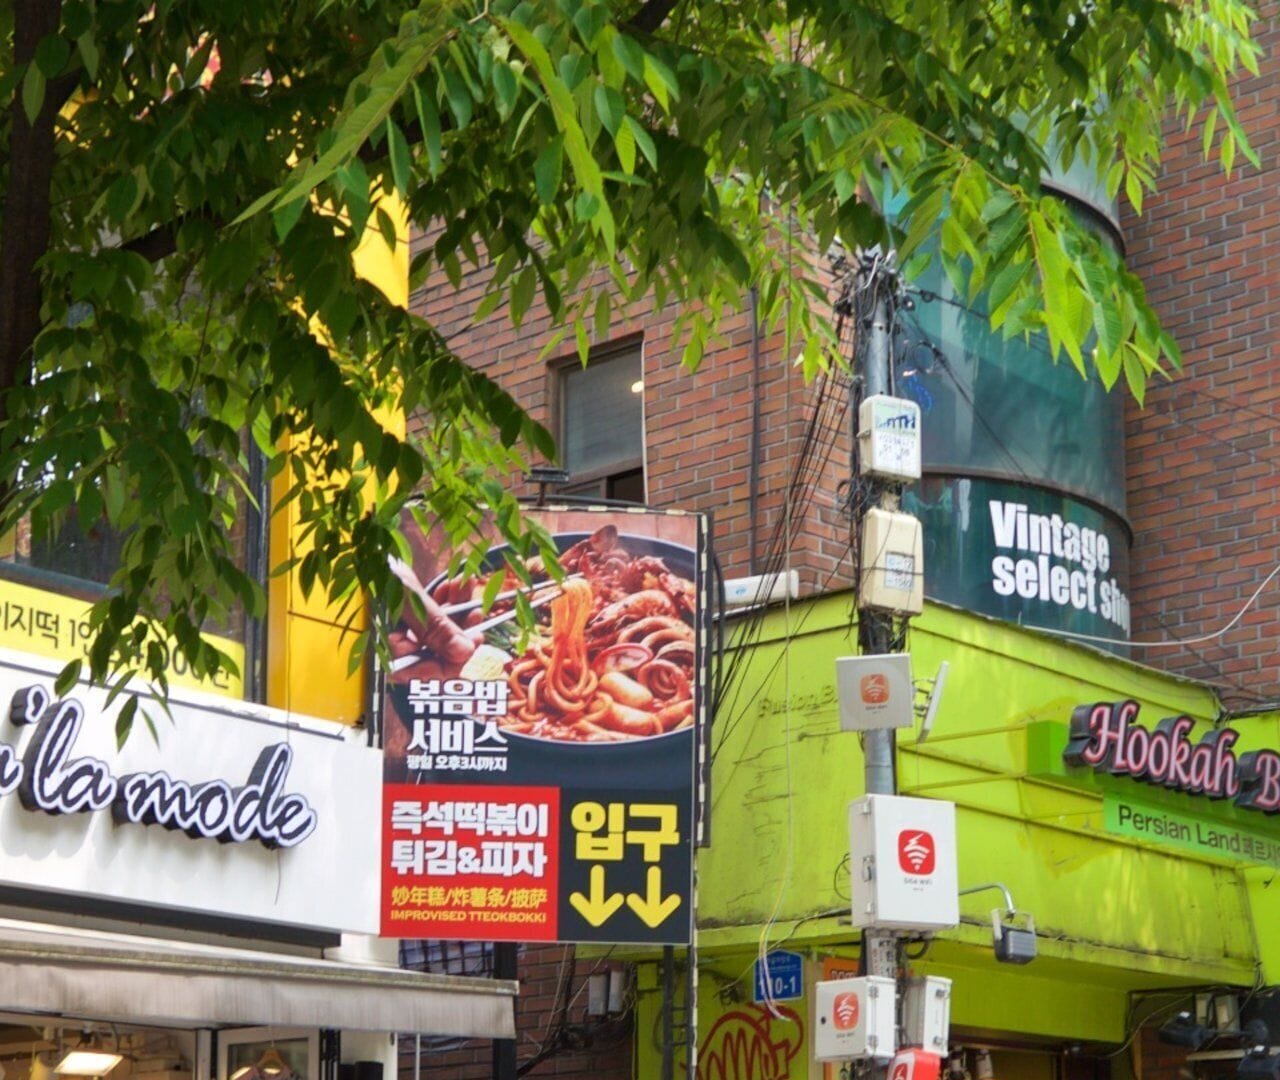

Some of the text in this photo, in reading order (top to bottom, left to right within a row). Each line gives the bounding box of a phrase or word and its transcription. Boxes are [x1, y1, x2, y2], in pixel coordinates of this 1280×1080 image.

[989, 500, 1110, 573] Vintage
[991, 554, 1097, 613] select
[406, 678, 512, 716] 볶음밥
[406, 718, 509, 754] 서비스
[1080, 699, 1241, 799] Hookah
[115, 742, 318, 850] mode
[391, 800, 549, 837] 즉석떡볶이
[571, 801, 680, 862] 입구
[1118, 803, 1191, 842] Persian
[1196, 823, 1241, 852] Land
[391, 840, 547, 877] 튀김&피자
[390, 910, 547, 924] IMPROVISED TTEOKBOKKI
